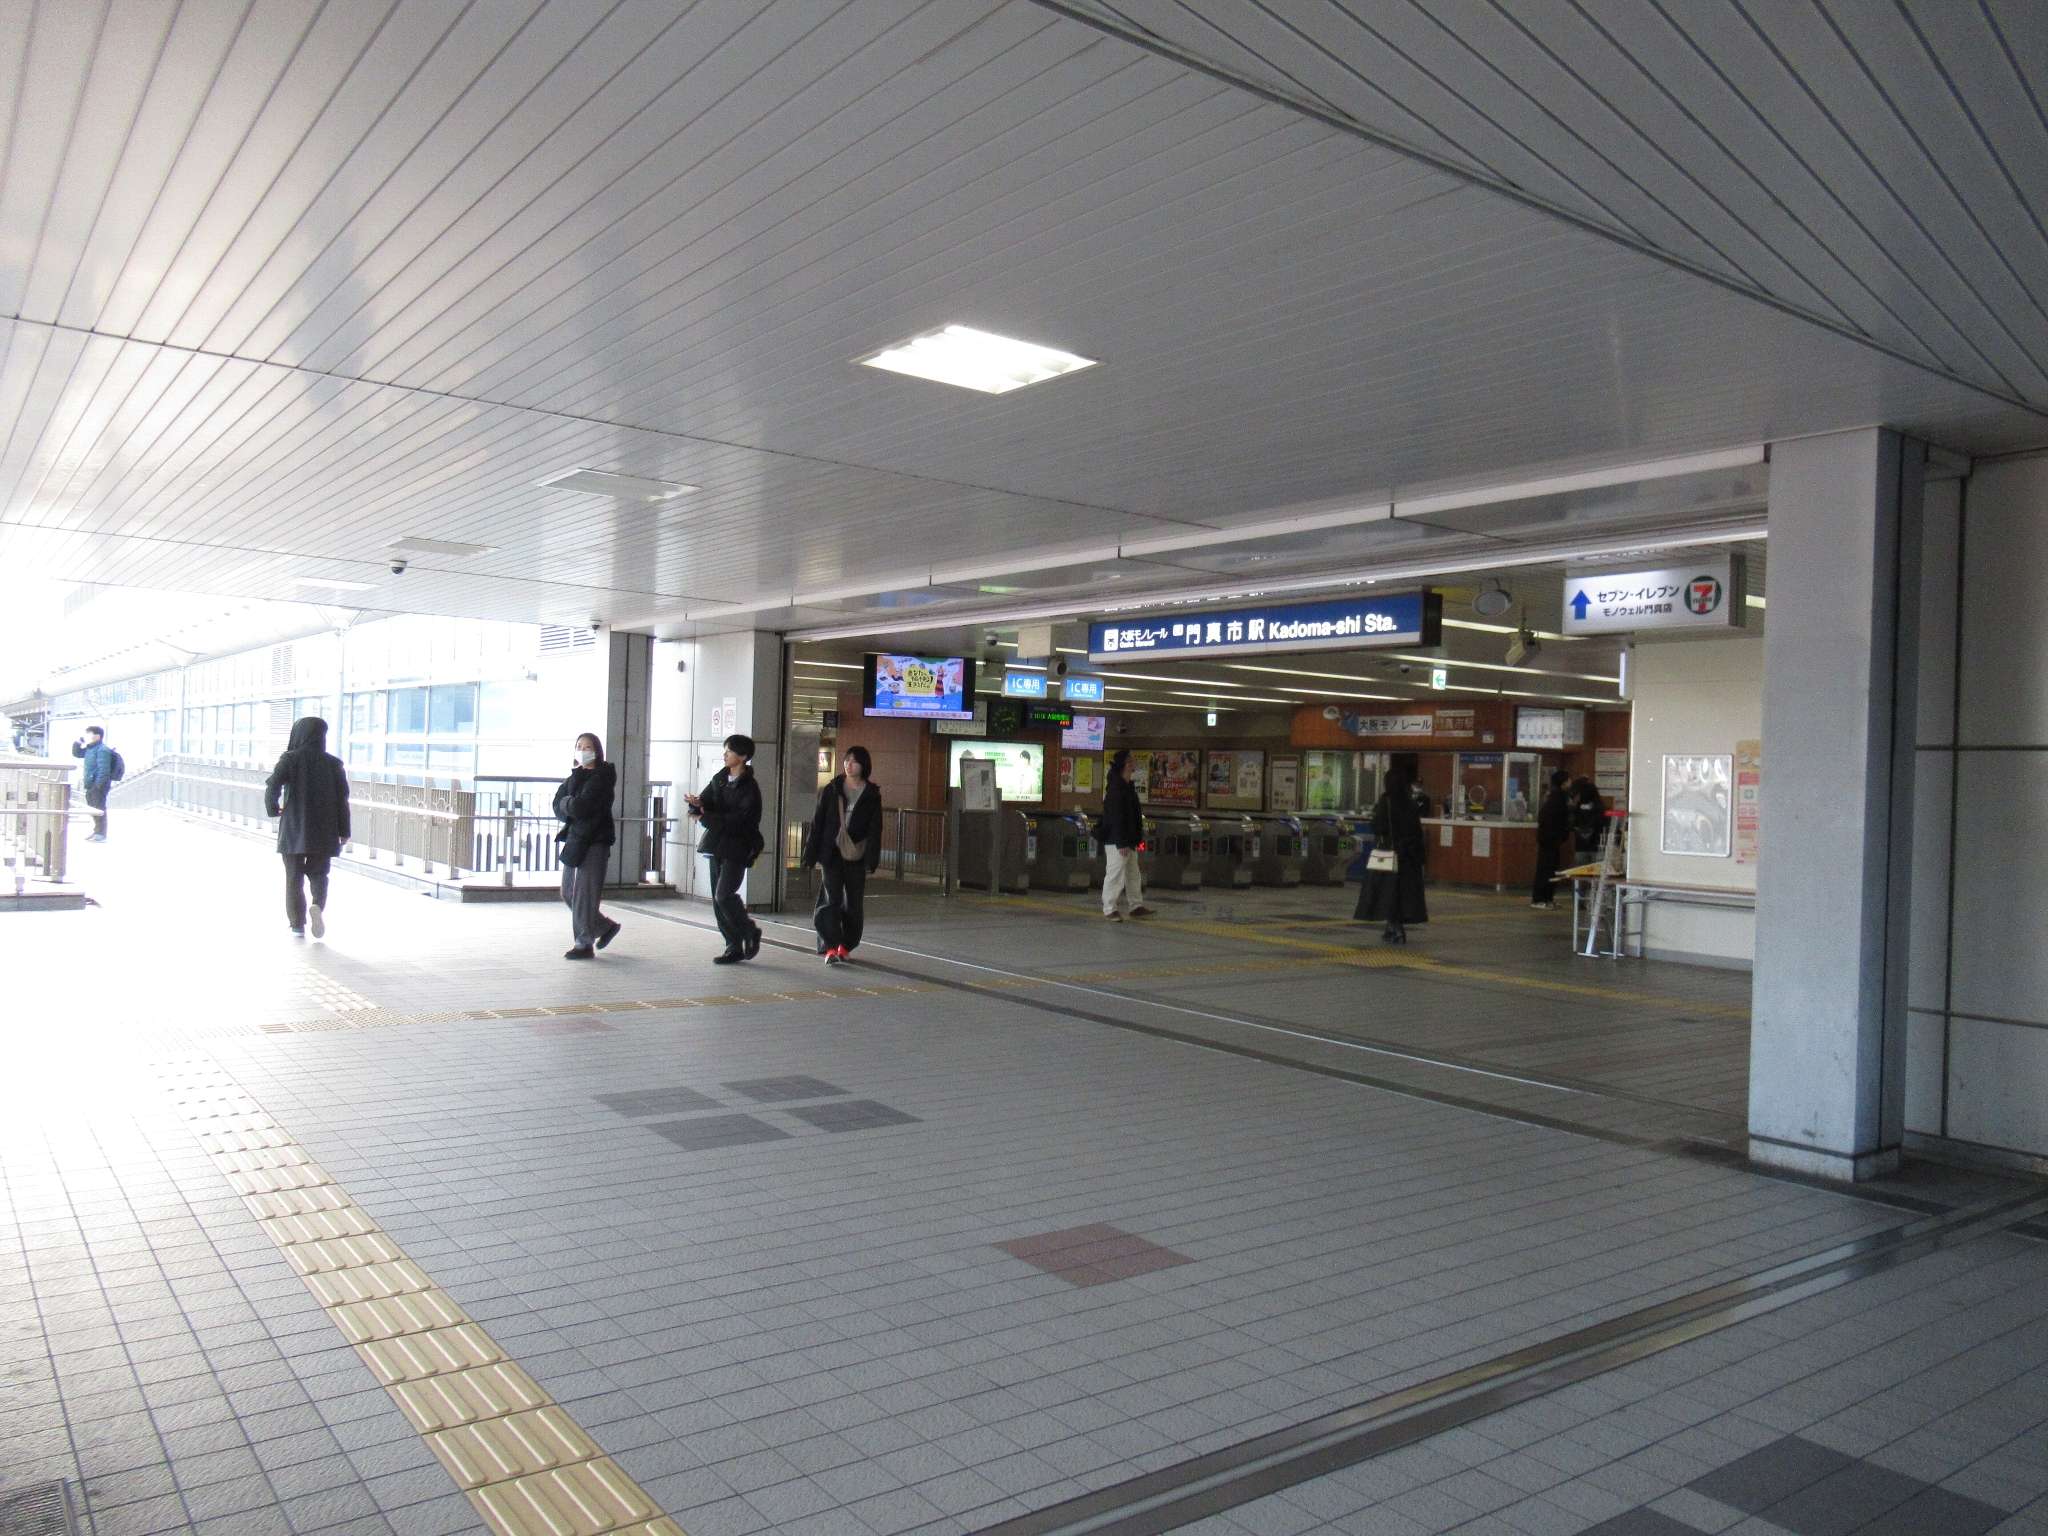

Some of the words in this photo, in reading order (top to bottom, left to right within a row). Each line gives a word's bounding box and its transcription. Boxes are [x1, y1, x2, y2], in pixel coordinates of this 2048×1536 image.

[1598, 585, 1680, 603] セブン・イレブン
[1120, 627, 1169, 642] 大阪モノレール
[1185, 618, 1265, 645] 門真市駅
[1269, 615, 1361, 640] Kadoma-shi
[1364, 613, 1398, 633] Sta.
[1011, 677, 1041, 690] IC専用
[1070, 682, 1098, 695] IC専用
[1359, 718, 1432, 731] 大阪モノレール
